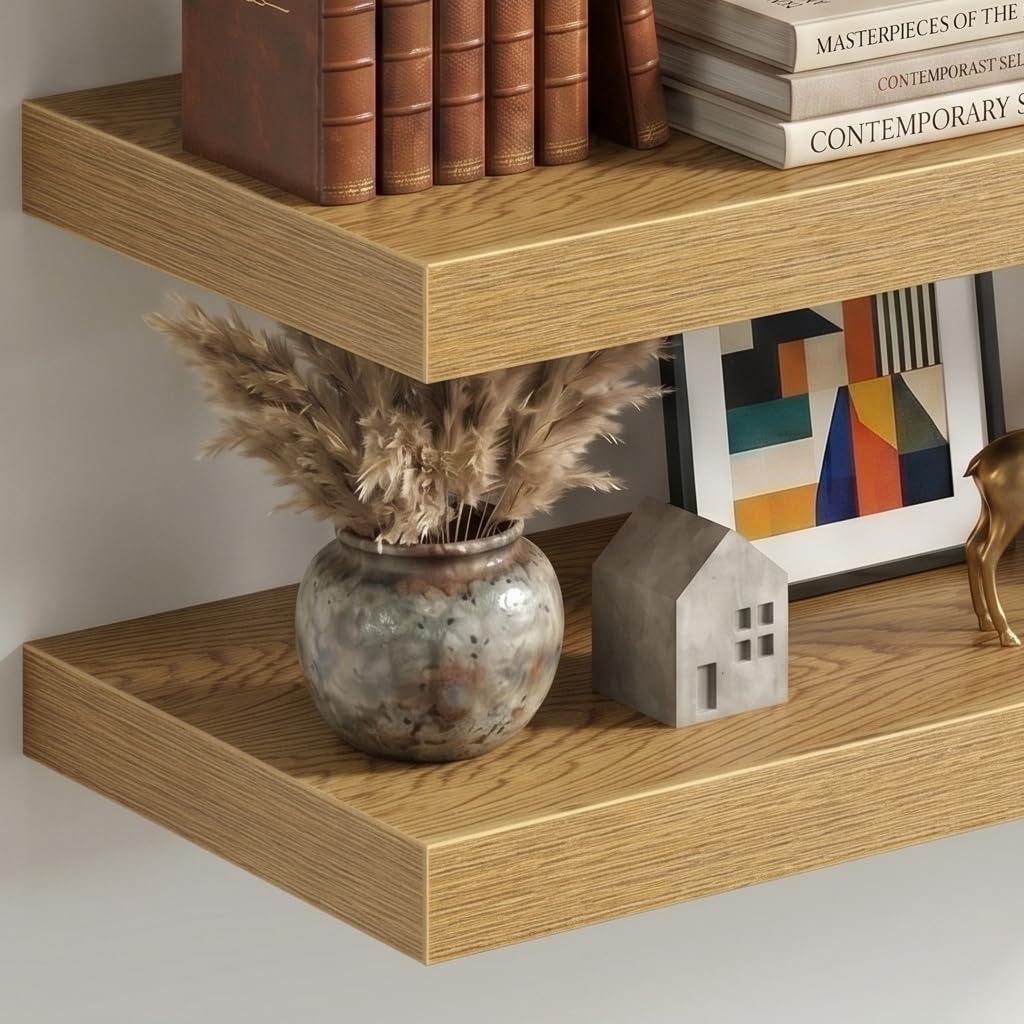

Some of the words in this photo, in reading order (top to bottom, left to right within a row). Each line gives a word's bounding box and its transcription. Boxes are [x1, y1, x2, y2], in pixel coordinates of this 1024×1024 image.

[816, 15, 949, 55] MASTERPIECES
[953, 10, 977, 30] OF
[980, 3, 1018, 25] THE
[877, 57, 997, 92] CONTEMPORAST
[810, 96, 1011, 154] CONTEMPORARY
